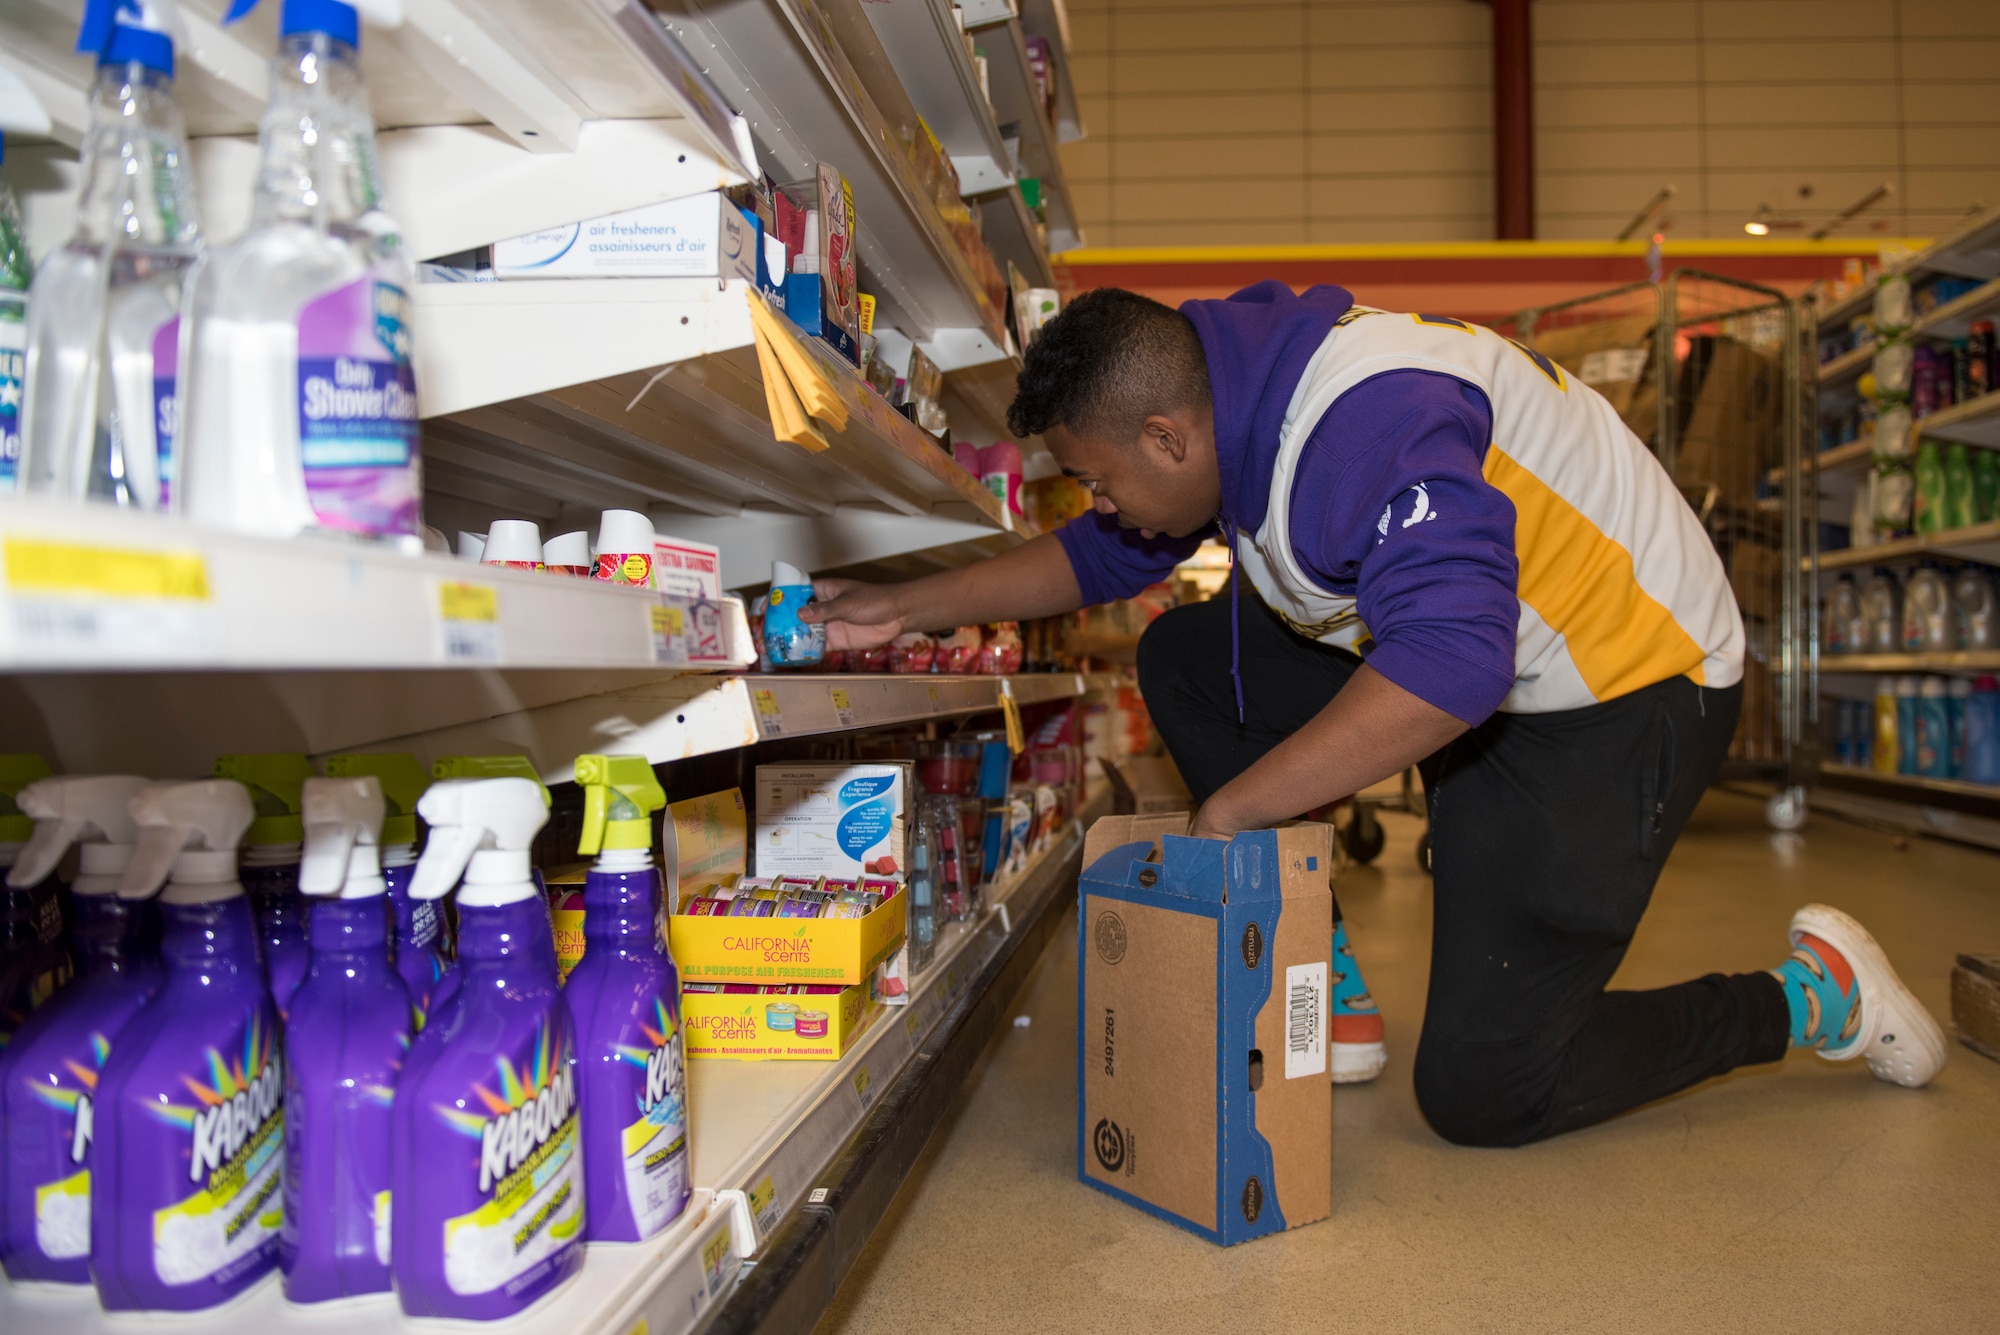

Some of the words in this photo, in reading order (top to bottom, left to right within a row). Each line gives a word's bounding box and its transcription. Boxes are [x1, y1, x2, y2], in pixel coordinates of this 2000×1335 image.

[589, 223, 606, 235] air
[611, 221, 676, 235] fresheners
[589, 239, 672, 252] assainisseurs
[677, 238, 706, 251] d'air
[763, 284, 785, 310] Refresh
[685, 556, 714, 574] SAVINGS
[723, 937, 810, 951] CALIFORNIA
[1248, 927, 1256, 965] renuzit
[763, 951, 810, 962] scents
[684, 965, 702, 976] ALL
[704, 965, 753, 977] PURPOSE
[755, 966, 775, 977] AIR
[777, 967, 845, 979] FRESHENERS
[711, 1028, 756, 1040] scents
[1104, 1008, 1114, 1077] 2497261
[768, 1046, 782, 1054] d'air
[787, 1047, 833, 1055] Aromatizantes
[479, 1053, 576, 1192] KABOOM
